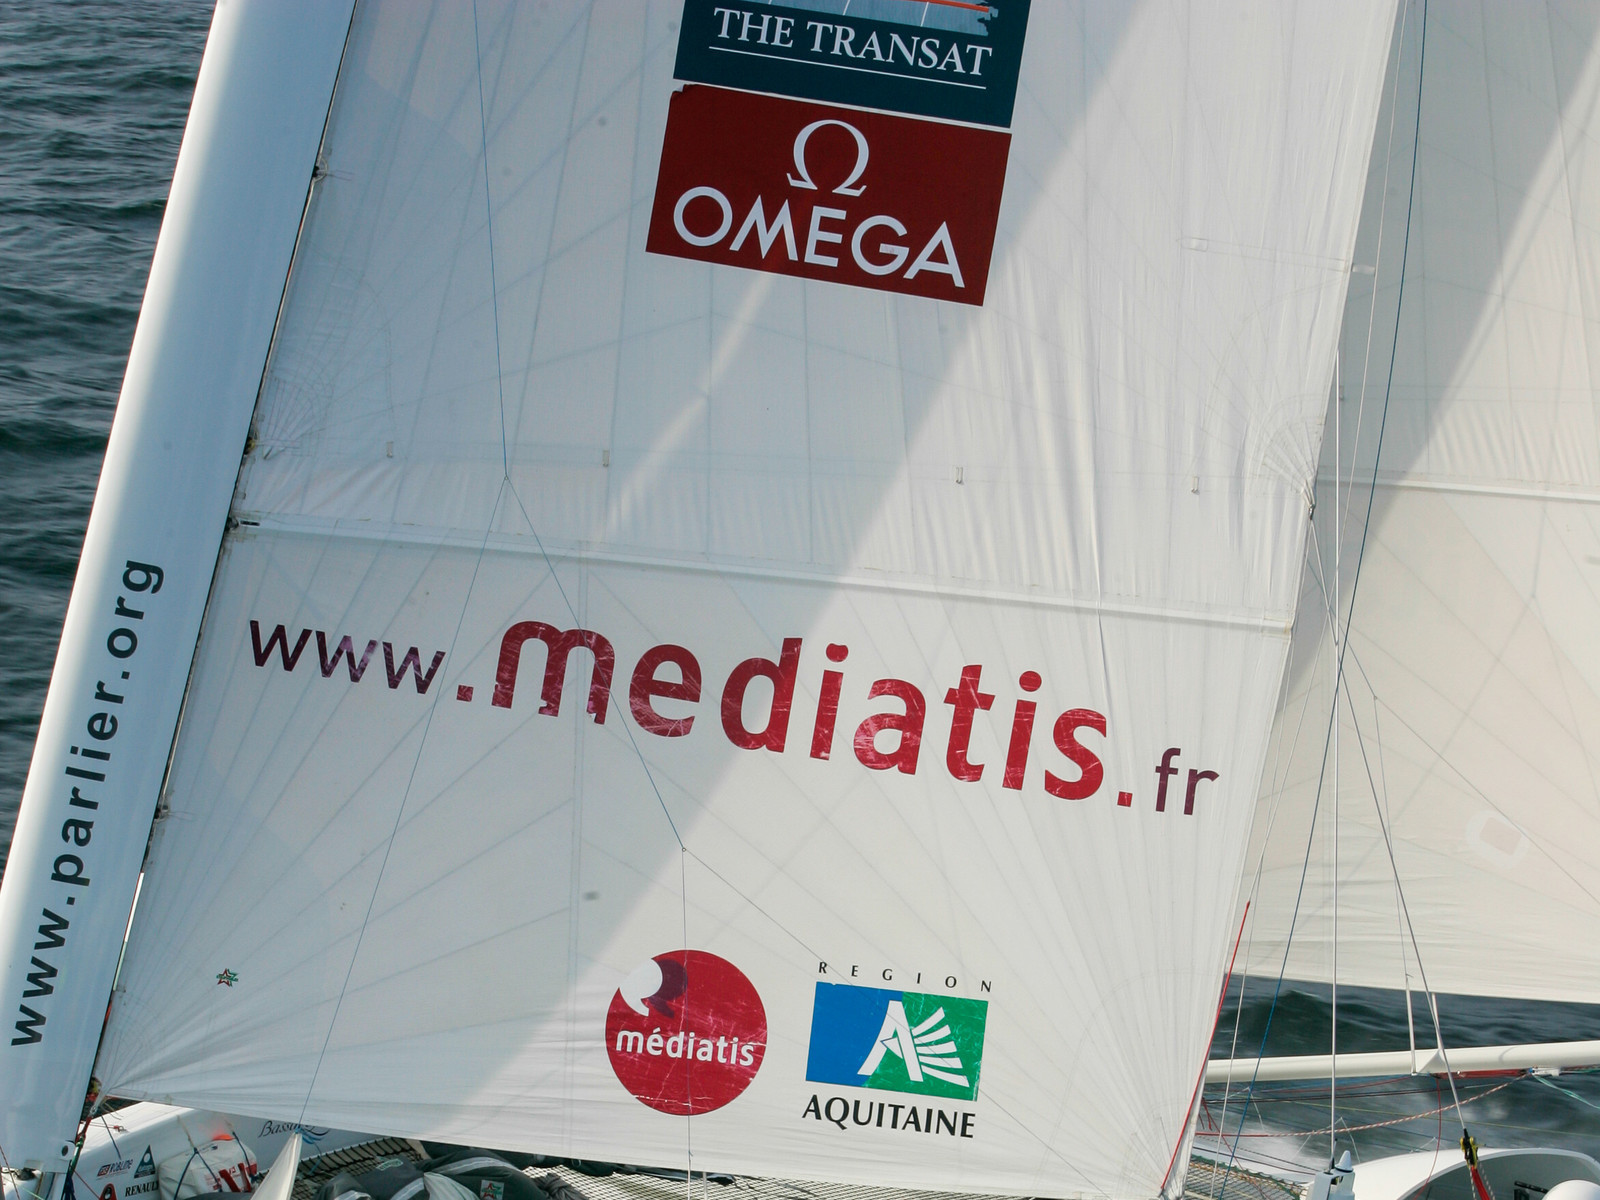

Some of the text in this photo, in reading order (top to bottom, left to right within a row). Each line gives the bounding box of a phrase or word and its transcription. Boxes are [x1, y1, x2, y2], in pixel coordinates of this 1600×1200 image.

[713, 7, 992, 76] THE TRANSAT
[673, 186, 966, 289] OMEGA
[249, 618, 1220, 816] www.mediatis.fr
[11, 560, 165, 1047] www.parlier.org
[818, 961, 992, 993] REGION
[615, 1026, 755, 1067] médiatis
[802, 1094, 977, 1139] AQUITAINE
